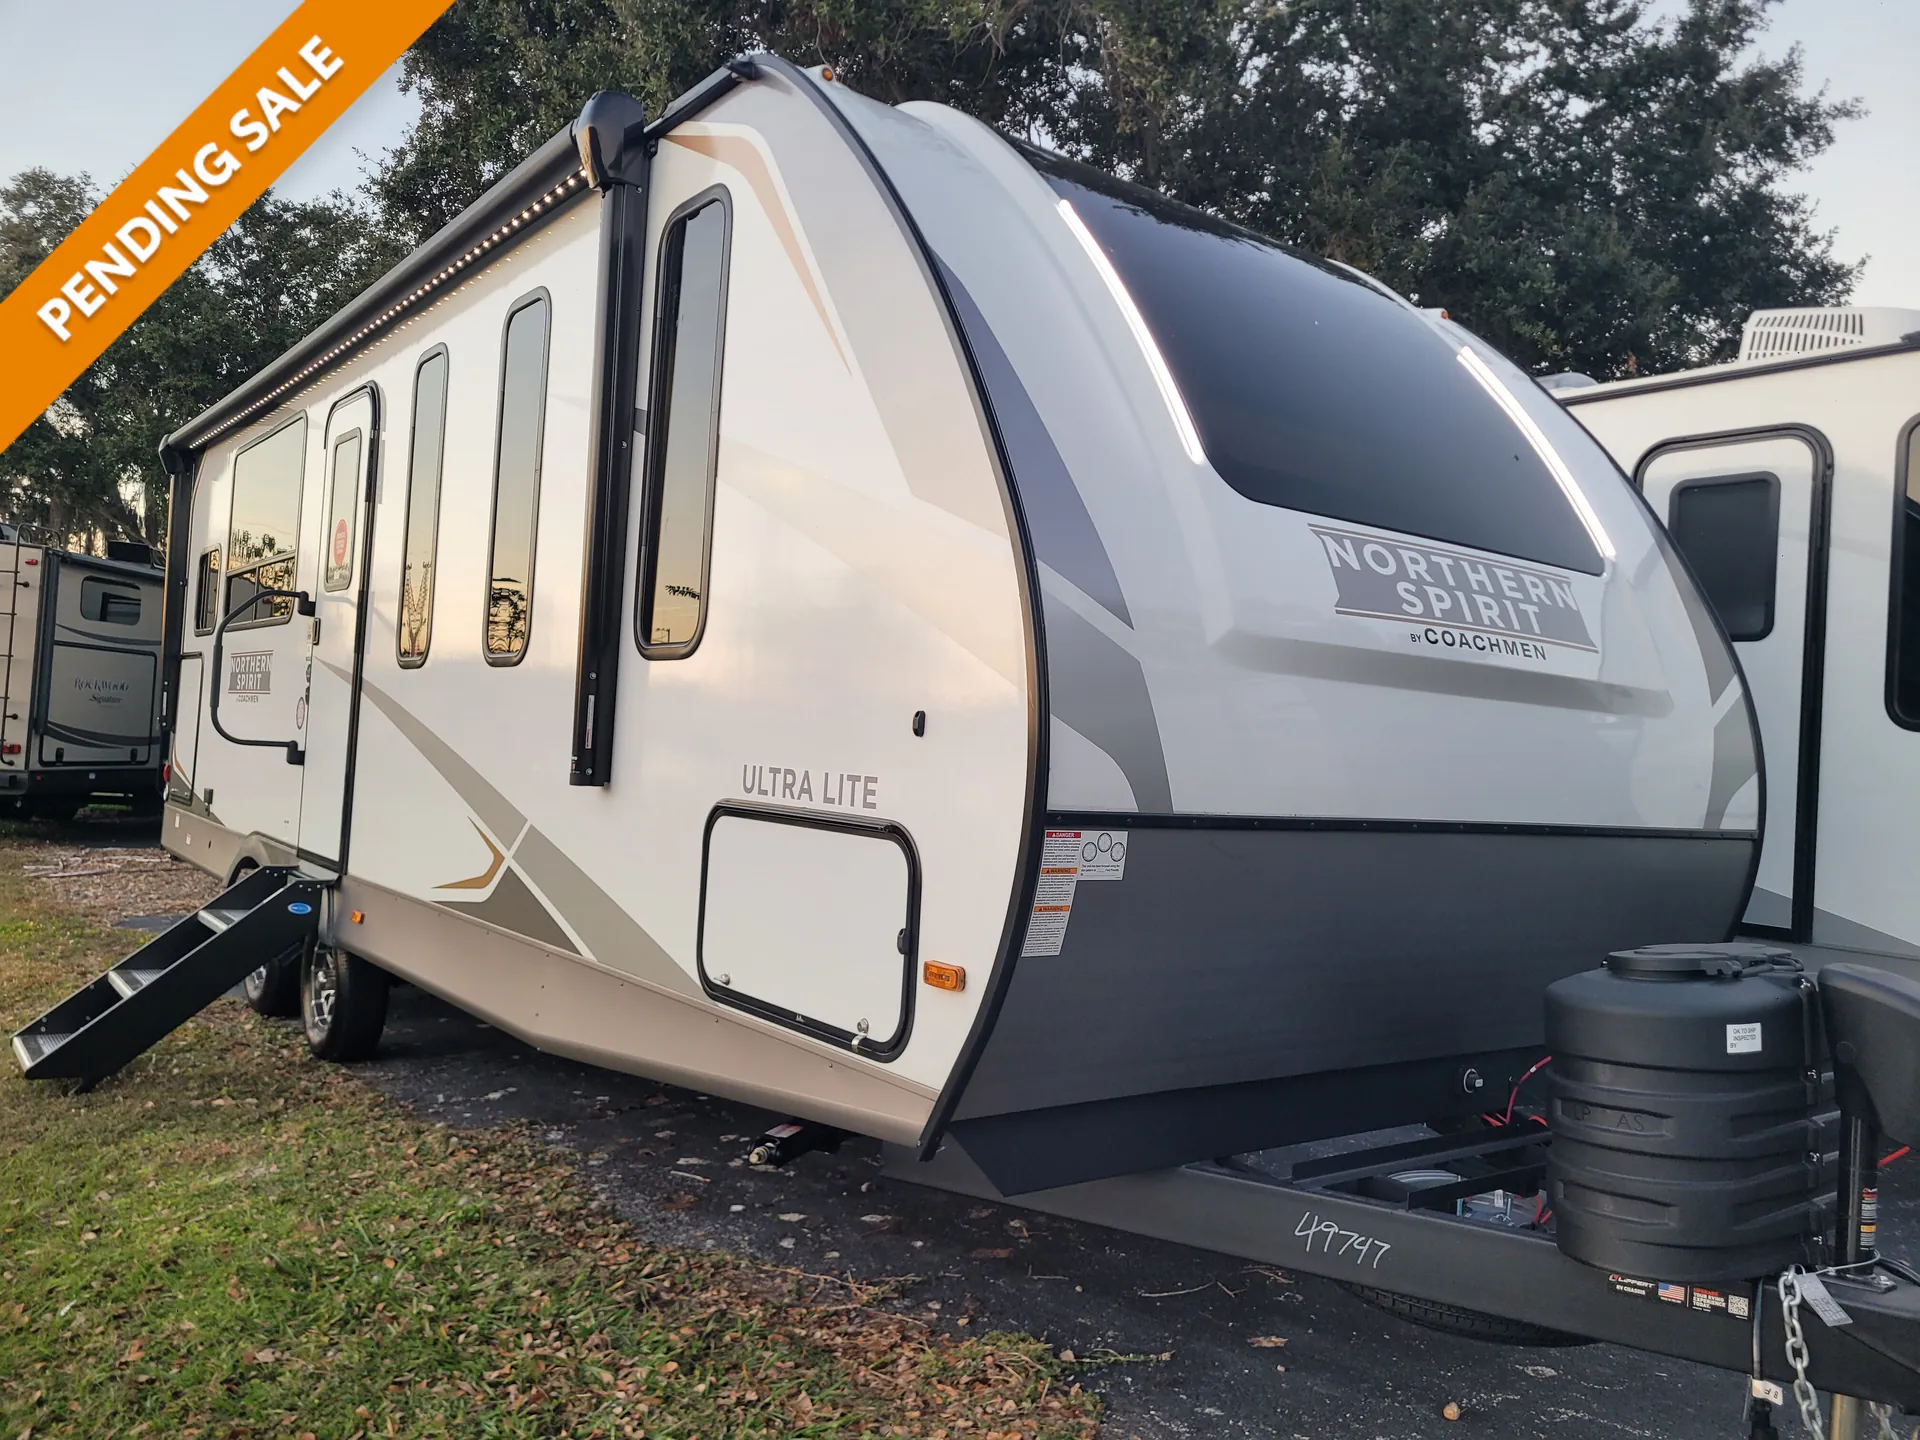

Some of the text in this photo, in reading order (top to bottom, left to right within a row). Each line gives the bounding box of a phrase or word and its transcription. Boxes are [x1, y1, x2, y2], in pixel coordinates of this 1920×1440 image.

[1319, 534, 1579, 611] NORTHERN
[1396, 581, 1542, 634] SPIRIT
[231, 655, 271, 673] NORTHERN
[1410, 628, 1547, 661] BY COACHMEN
[236, 673, 262, 690] SPIRIT
[742, 764, 878, 809] ULTRA LITE
